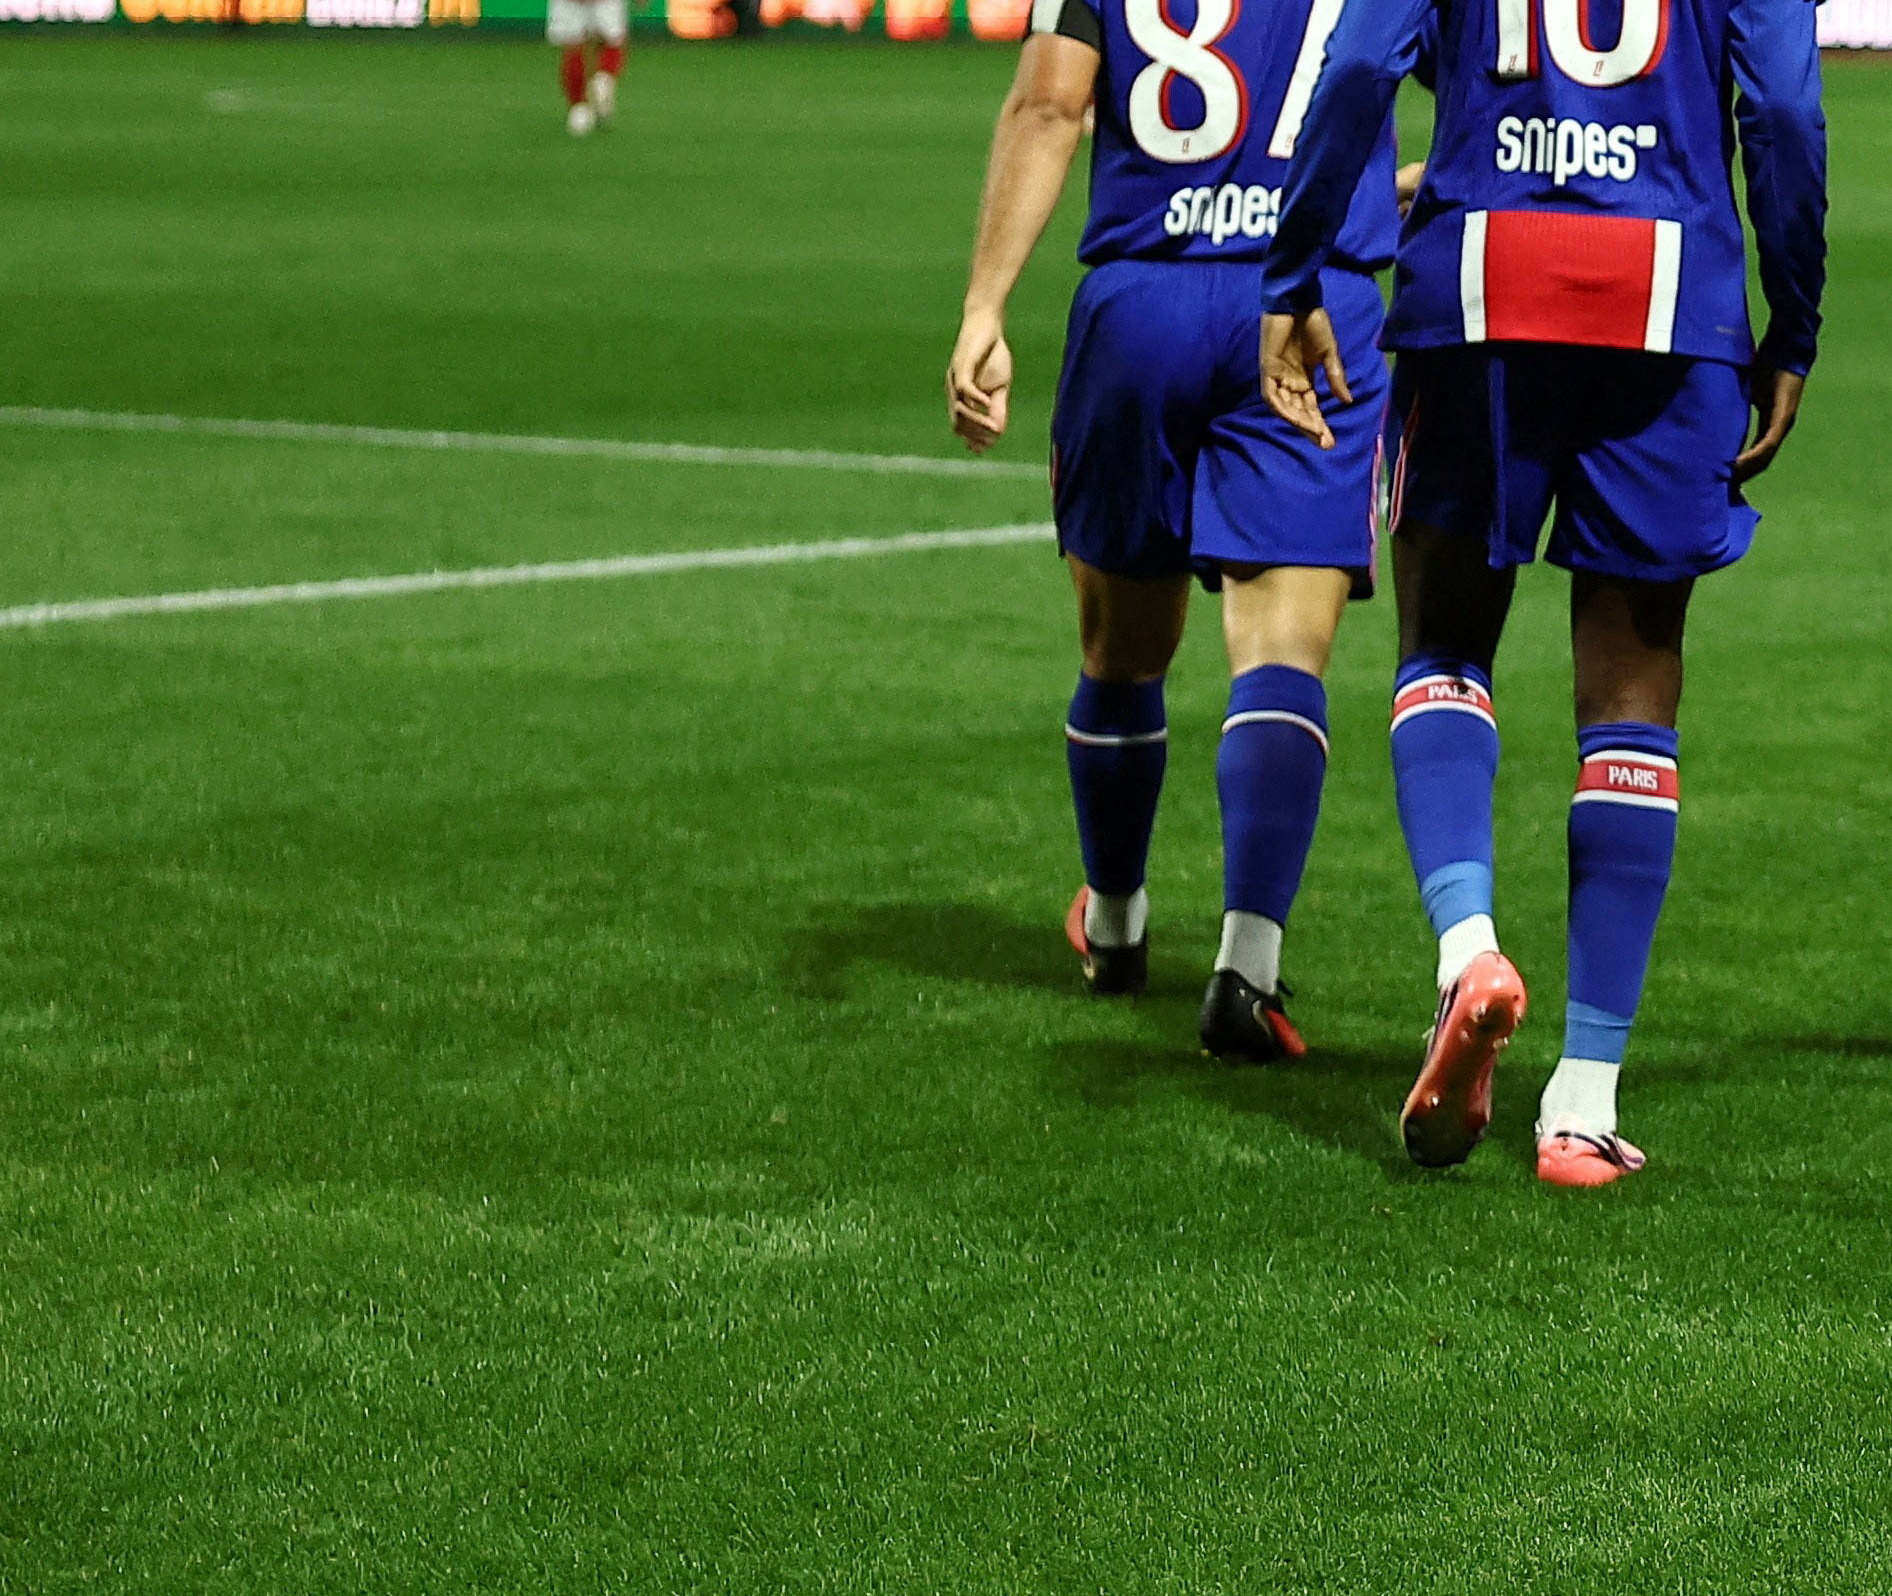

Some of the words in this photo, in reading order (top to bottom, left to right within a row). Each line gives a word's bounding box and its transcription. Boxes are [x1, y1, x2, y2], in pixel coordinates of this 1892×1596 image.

[1497, 116, 1640, 186] snipes
[1427, 683, 1478, 704] PAS
[1608, 764, 1658, 790] PARIS
